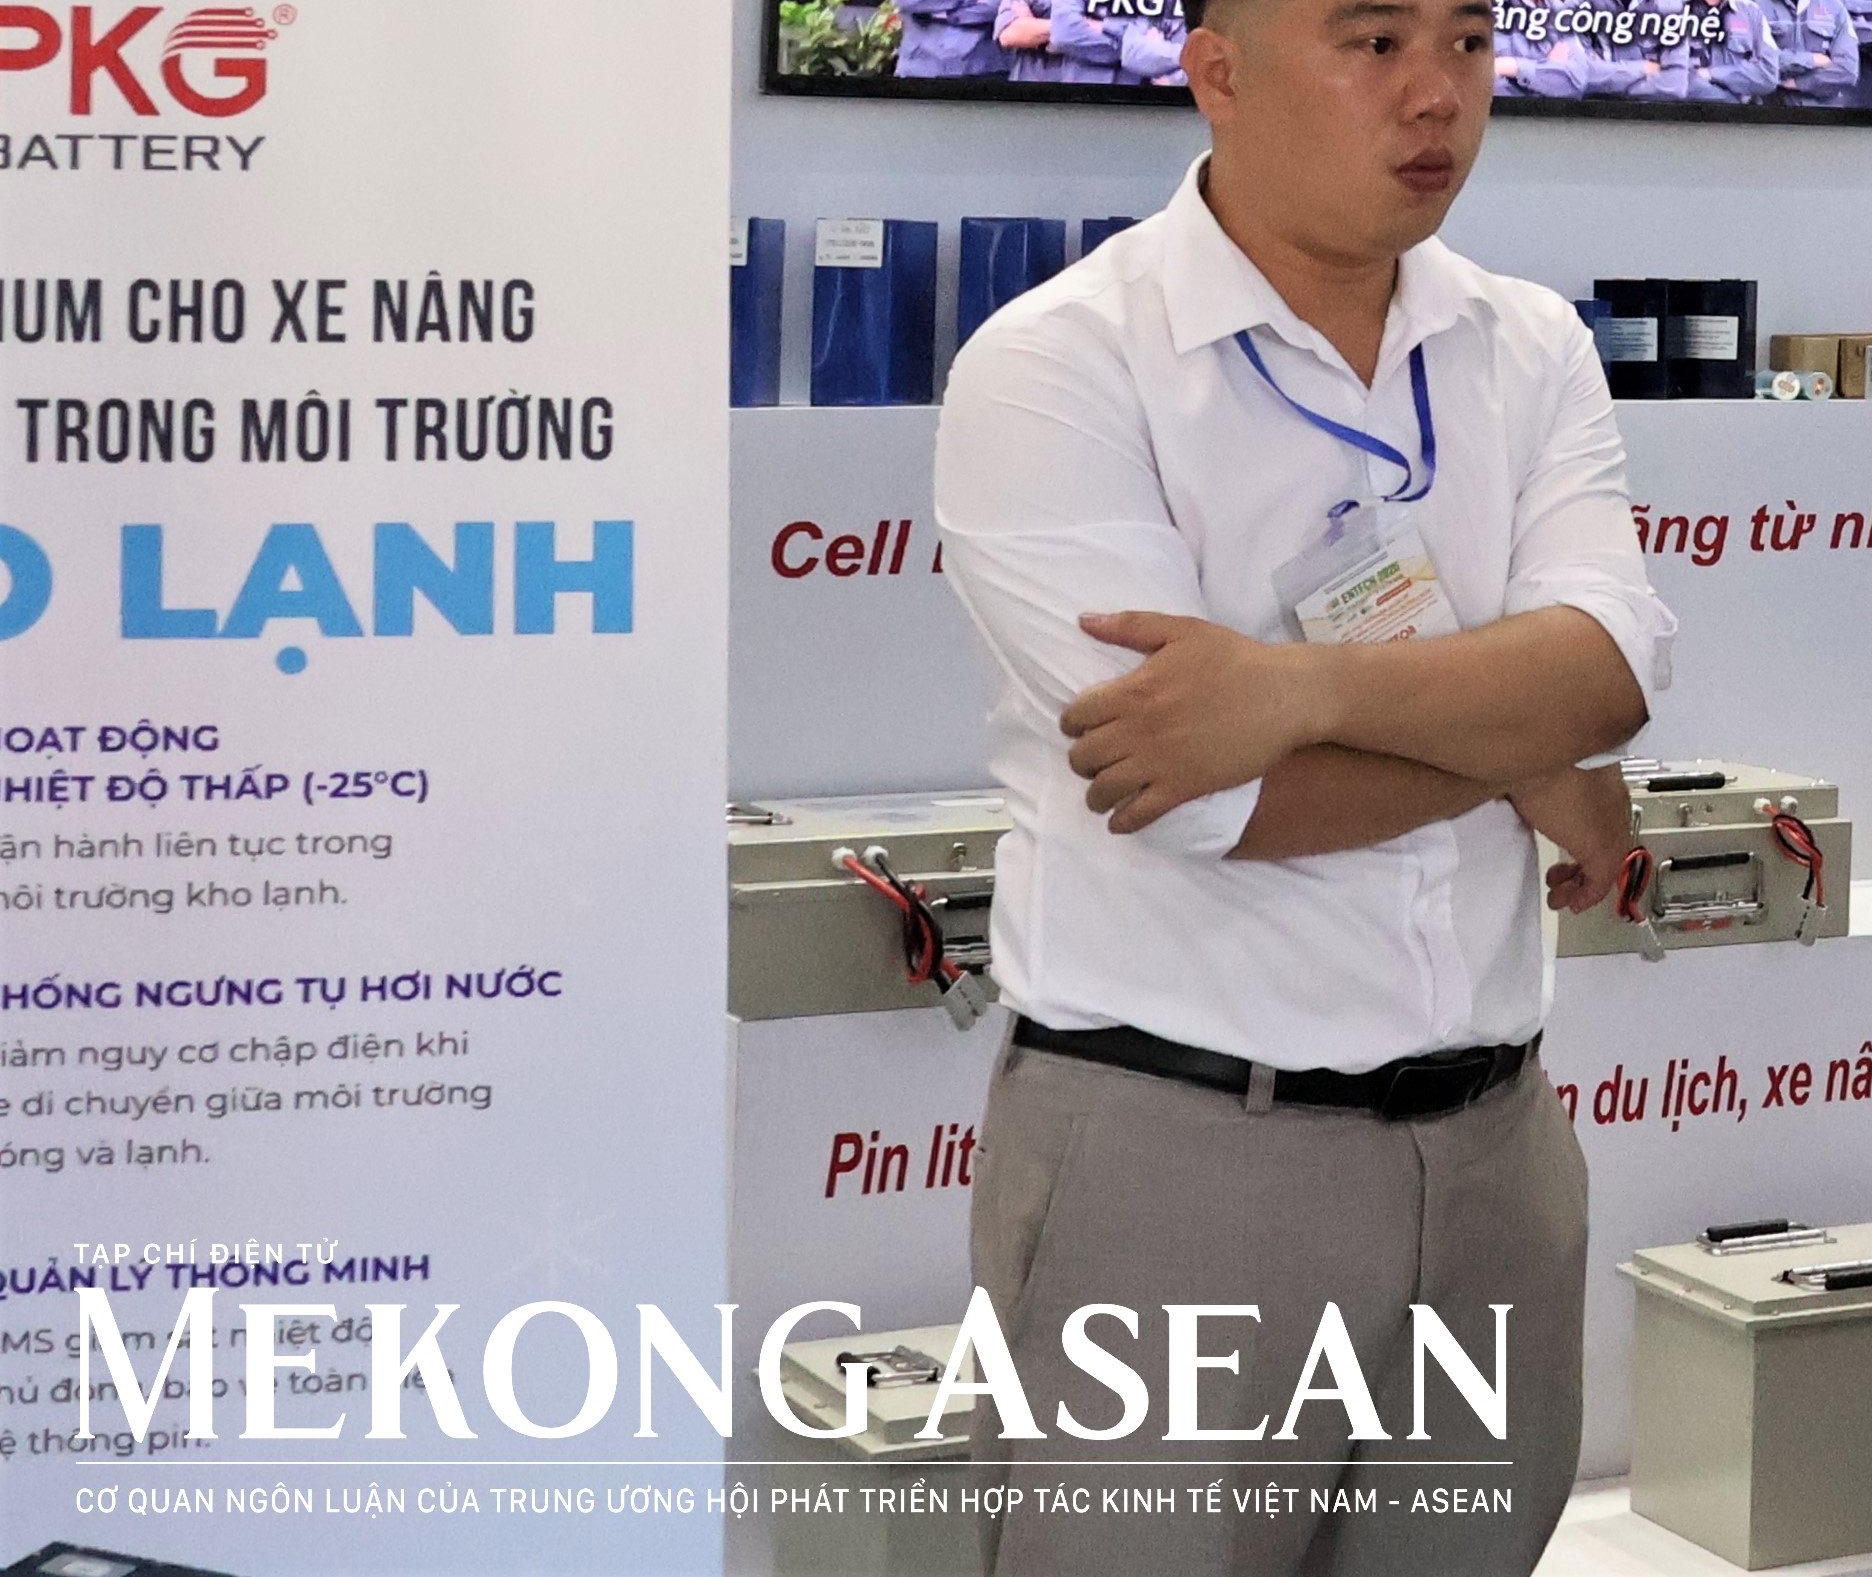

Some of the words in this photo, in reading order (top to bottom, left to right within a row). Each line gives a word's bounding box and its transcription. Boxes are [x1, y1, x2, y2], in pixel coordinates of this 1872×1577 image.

[0, 5, 275, 117] PKG
[129, 279, 244, 343] CHO
[271, 280, 346, 342] XE
[373, 271, 534, 343] NÂNG
[17, 399, 214, 463] TRONG
[242, 390, 350, 462] MÔI
[376, 395, 612, 461] TRƯỜNG
[771, 519, 913, 580] Cell
[1751, 500, 1814, 552] từ
[120, 521, 633, 675] LẠNH
[136, 976, 282, 1007] NGƯNG
[295, 977, 346, 1009] TỤ
[361, 971, 430, 1001] HƠI
[446, 965, 561, 999] NƯỚC
[826, 1128, 911, 1198] Pin
[1593, 1063, 1649, 1125] du
[1661, 1055, 1748, 1132] lịch,
[1762, 1062, 1813, 1109] xe
